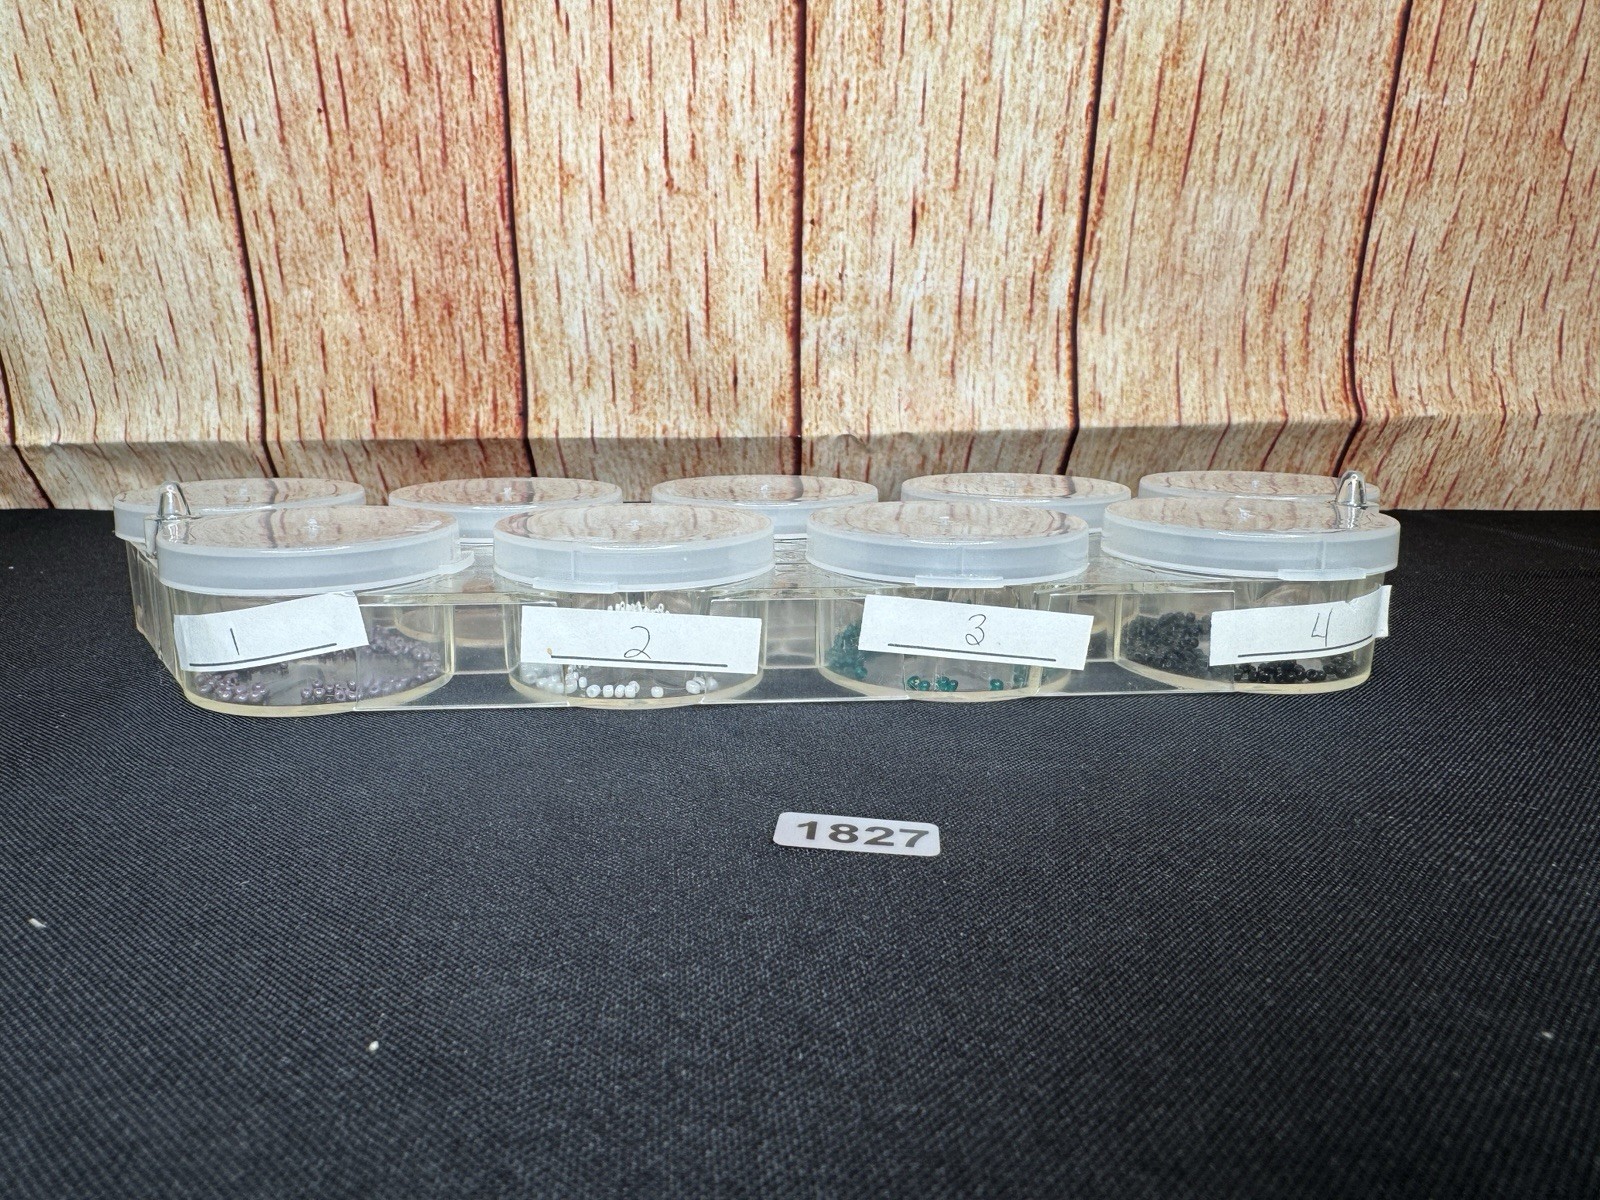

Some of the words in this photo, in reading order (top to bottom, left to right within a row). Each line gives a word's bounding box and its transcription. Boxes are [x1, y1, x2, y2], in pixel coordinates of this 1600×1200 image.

[623, 625, 652, 660] 2
[965, 613, 987, 646] 3
[1311, 608, 1334, 647] 4
[797, 820, 930, 848] 1827
